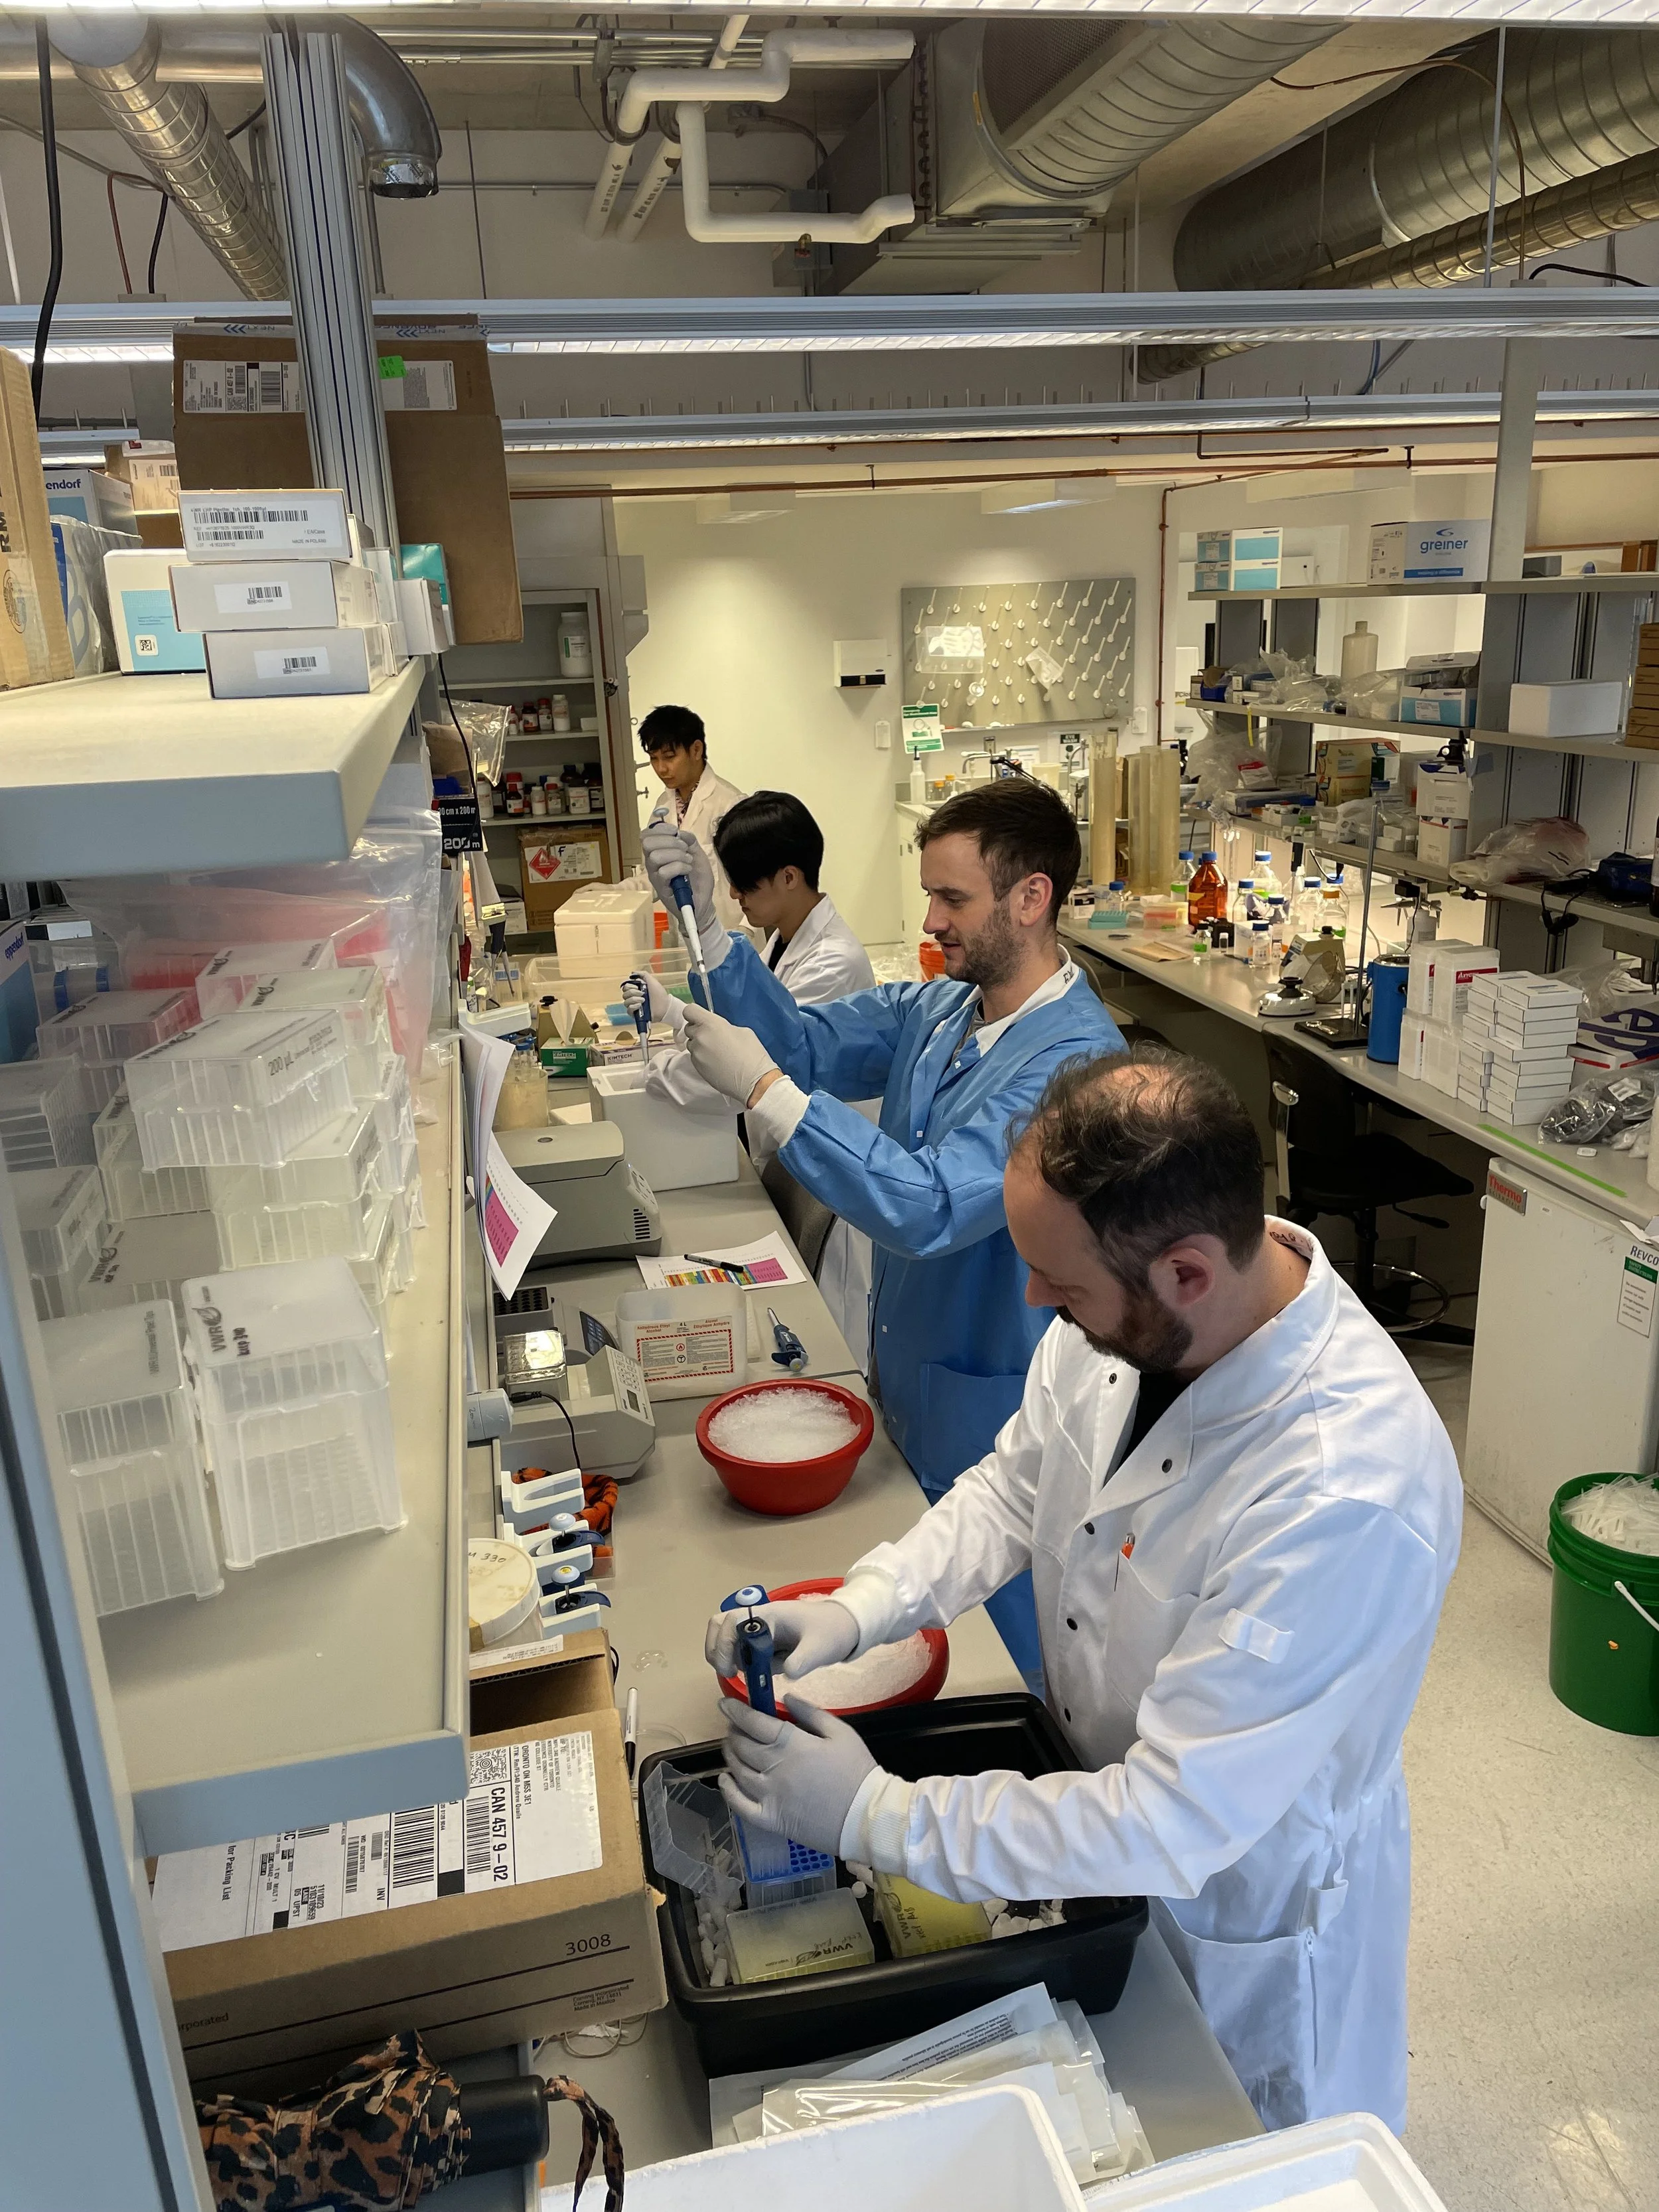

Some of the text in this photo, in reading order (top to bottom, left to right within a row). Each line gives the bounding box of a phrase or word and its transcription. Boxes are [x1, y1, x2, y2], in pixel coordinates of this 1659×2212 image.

[1420, 540, 1469, 553] greiner
[460, 806, 470, 815] 200
[443, 837, 470, 849] 200
[5, 932, 25, 961] eppendorf
[1489, 1173, 1522, 1204] Thermo
[1630, 1245, 1659, 1266] REVCO
[208, 1326, 227, 1353] VWR
[480, 1553, 506, 1563] 330
[523, 1770, 530, 1779] ON
[491, 1787, 506, 1813] CAN
[492, 1817, 507, 1838] 457
[222, 1856, 236, 1885] Packing
[222, 1886, 232, 1901] List
[294, 1888, 302, 1897] 05
[317, 1884, 325, 1909] 11/10/23
[897, 1913, 911, 1939] VWR
[565, 1933, 611, 1956] 3008
[823, 1943, 853, 1955] VWR
[573, 1993, 595, 2002] Corning
